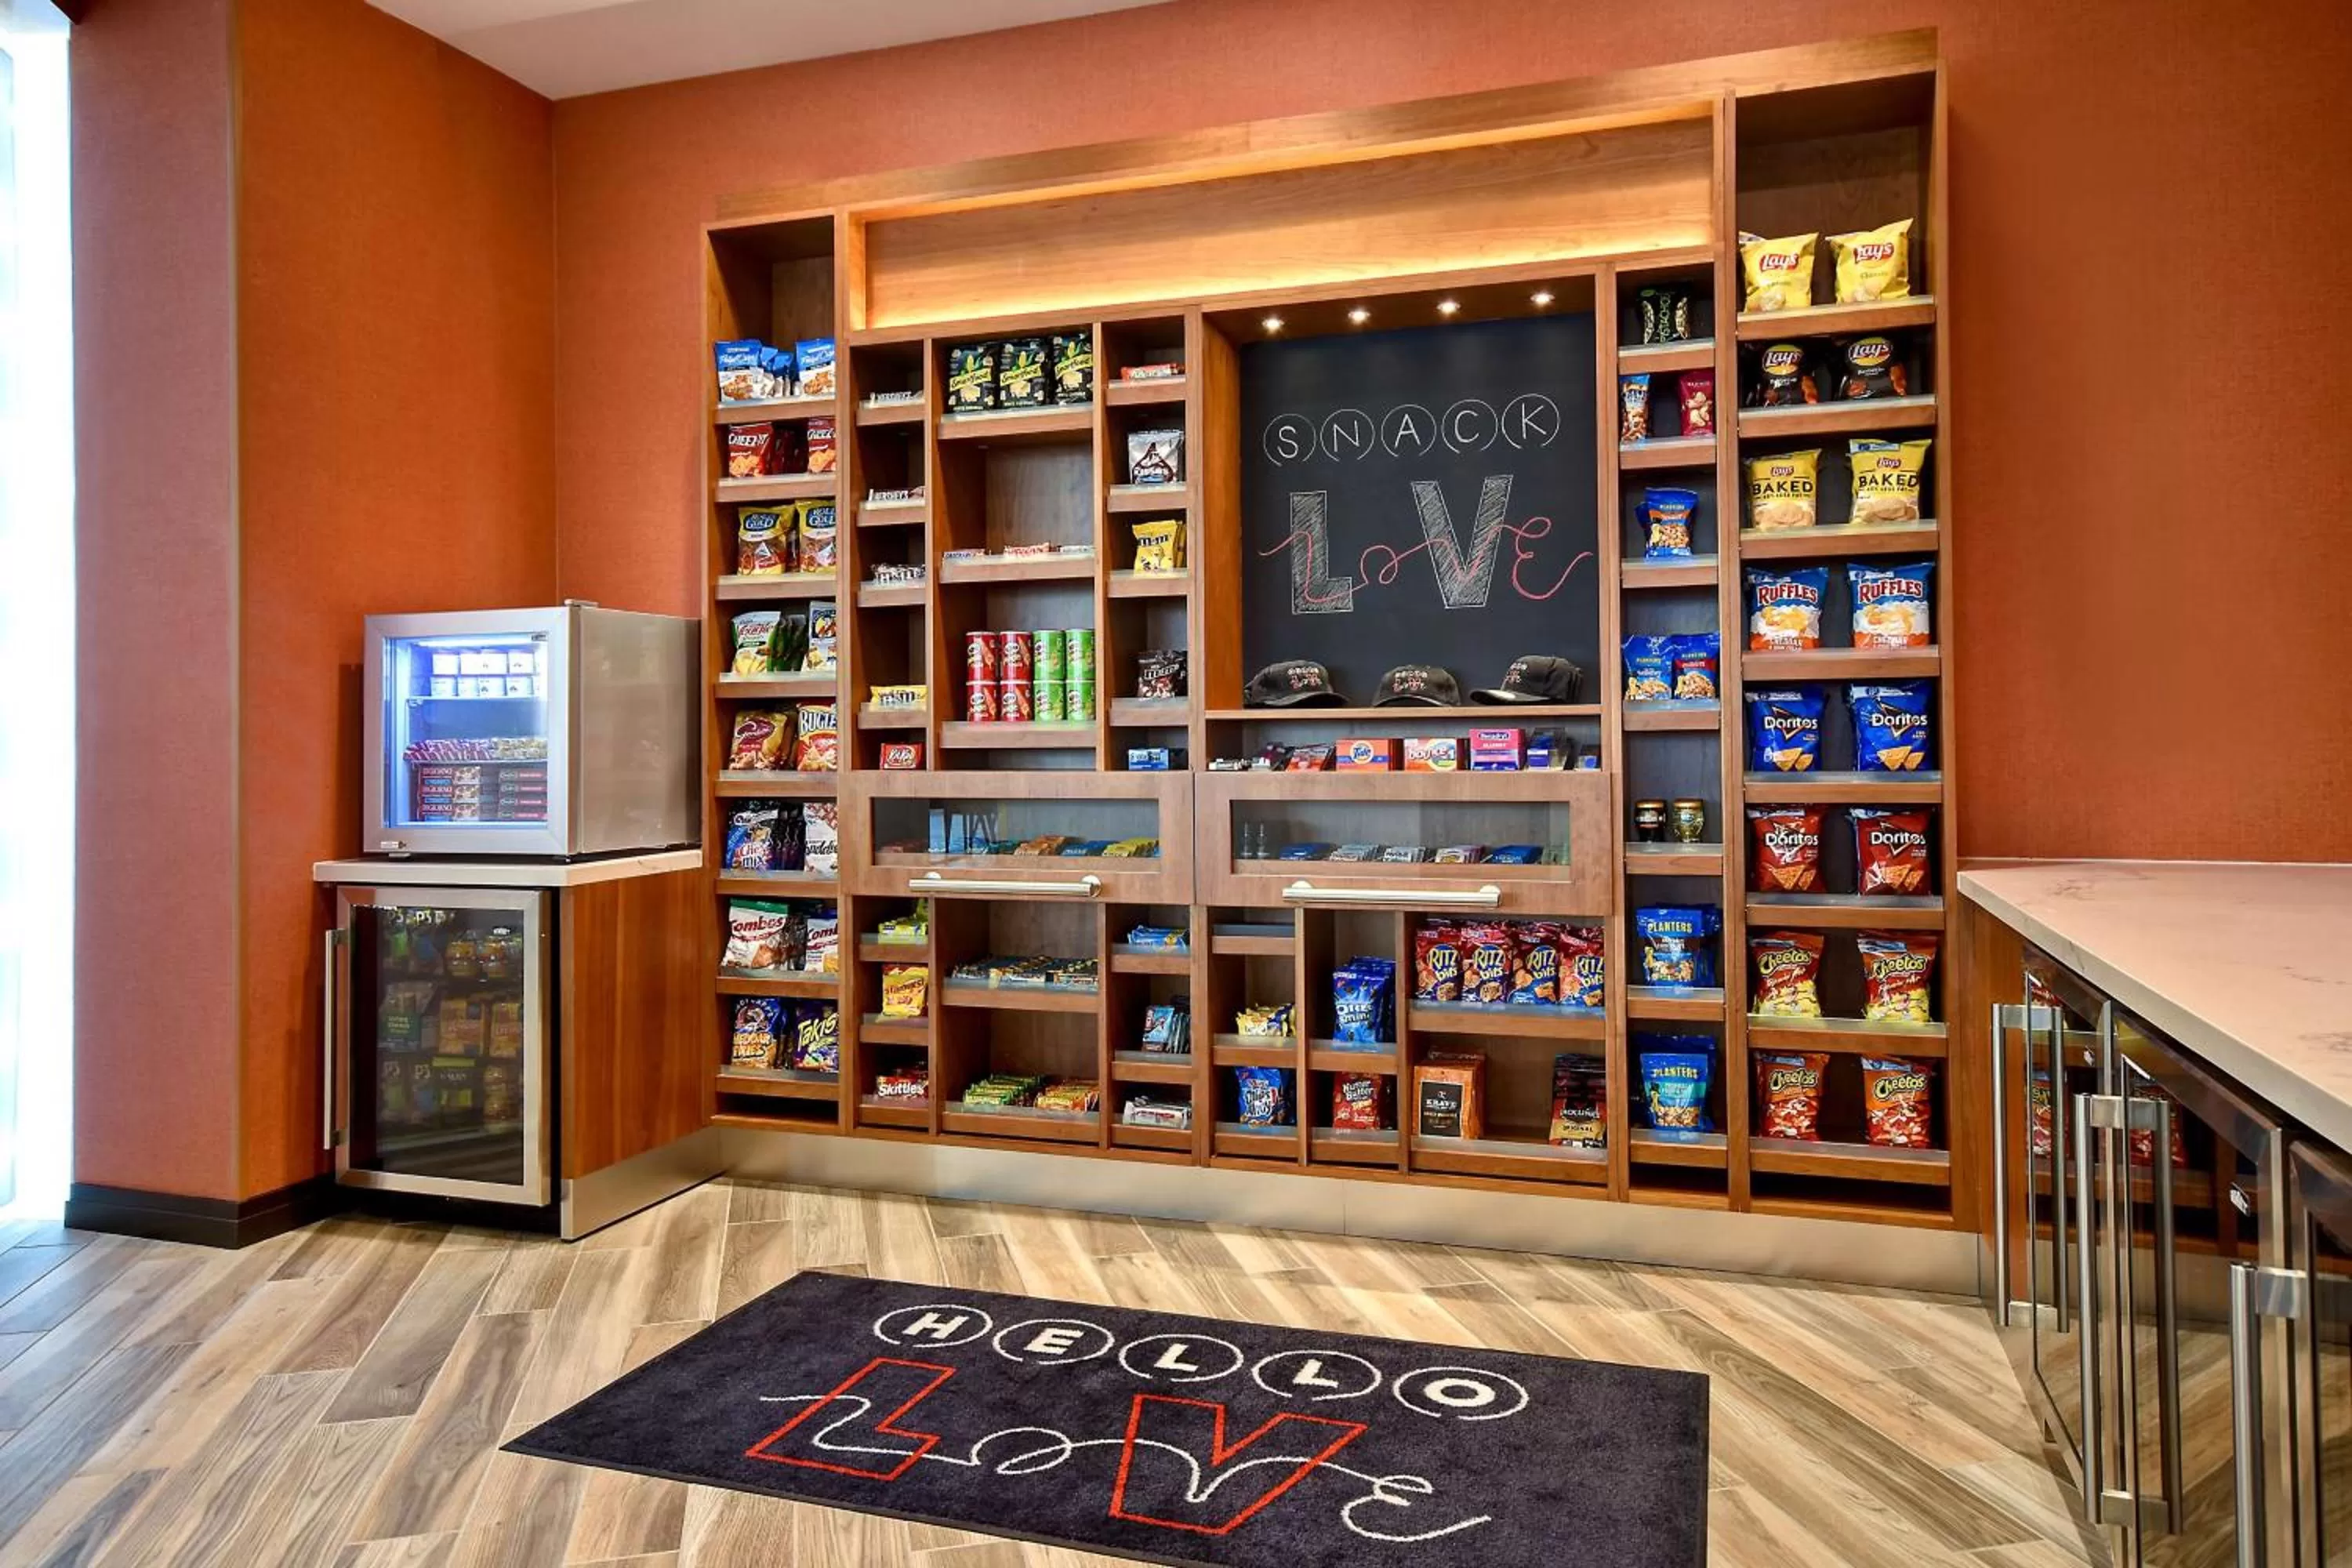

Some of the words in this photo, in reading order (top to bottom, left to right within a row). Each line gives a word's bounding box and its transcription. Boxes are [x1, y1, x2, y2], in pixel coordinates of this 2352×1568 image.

[1276, 400, 1548, 459] SNACK
[1752, 481, 1813, 495] BAKED
[1859, 474, 1919, 488] BAKED
[1758, 583, 1818, 604] RUFFLES
[1858, 579, 1923, 603] RUFFLES
[800, 710, 837, 733] BUGLE
[1764, 716, 1818, 729] Doritos
[1871, 713, 1928, 727] Doritos
[1766, 832, 1818, 846] Doritos
[1871, 831, 1926, 845] Doritos
[1428, 949, 1459, 968] RITZ
[1473, 949, 1504, 968] RITZ
[1528, 949, 1556, 969] RITZ
[1759, 950, 1810, 975] Cheetos
[1873, 956, 1925, 978] Cheetos
[1436, 967, 1458, 981] bits
[1480, 966, 1503, 980] bits
[1532, 966, 1555, 979] bits
[797, 1013, 839, 1052] Takis
[1770, 1069, 1817, 1091] Cheetos
[1874, 1075, 1926, 1098] Cheetos
[877, 1083, 924, 1097] Skittles
[898, 1309, 1499, 1408] HELLO
